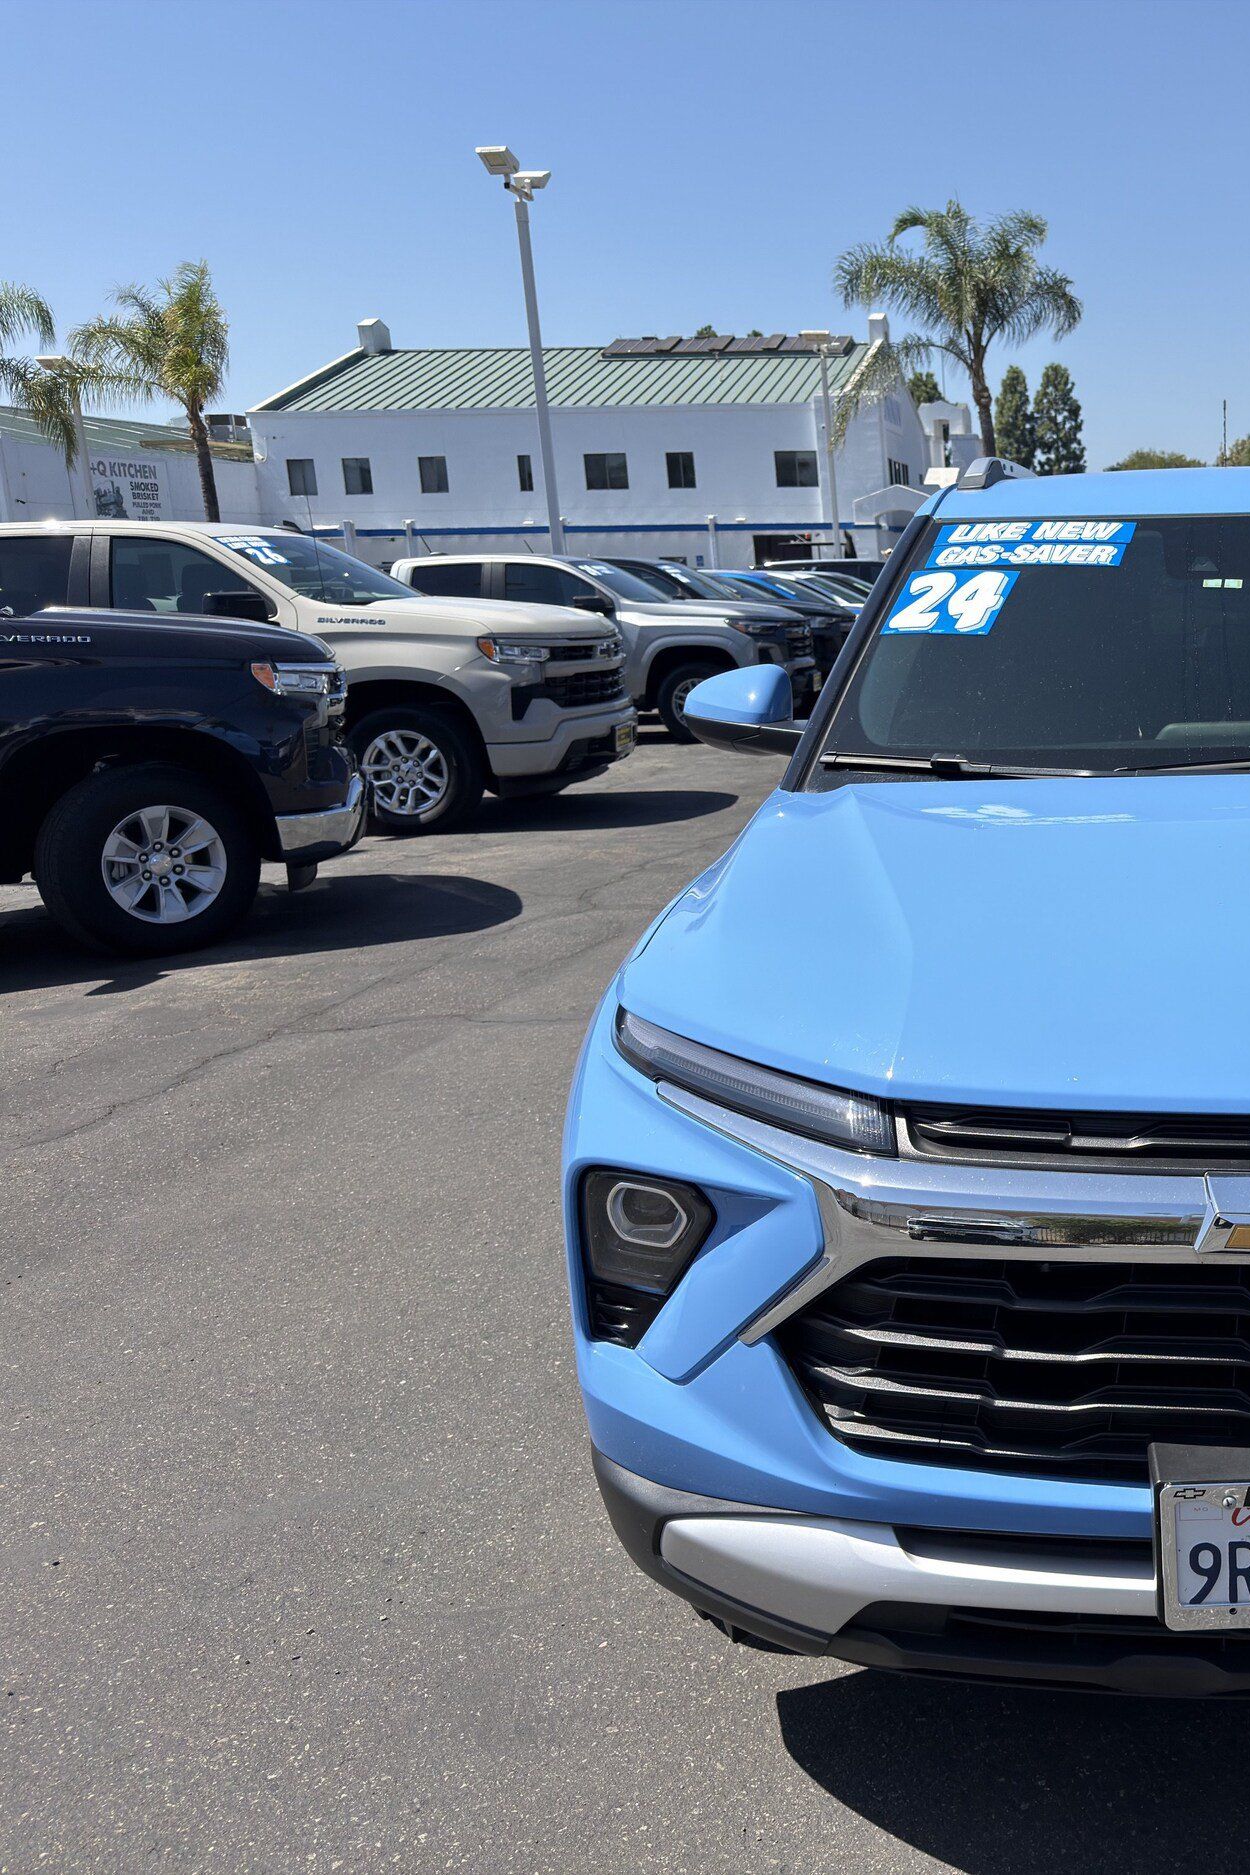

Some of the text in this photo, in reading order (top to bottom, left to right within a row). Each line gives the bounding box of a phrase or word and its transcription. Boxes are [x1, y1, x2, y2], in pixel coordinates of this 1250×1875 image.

[109, 462, 158, 479] KITCHEN
[129, 481, 159, 492] SMOKED
[132, 492, 159, 501] BRISKET
[947, 522, 1123, 544] LIKE NEW
[244, 547, 288, 565] 26
[935, 544, 1118, 566] GAS-SAVER
[888, 571, 1009, 632] 24
[317, 617, 386, 626] SILVERADO
